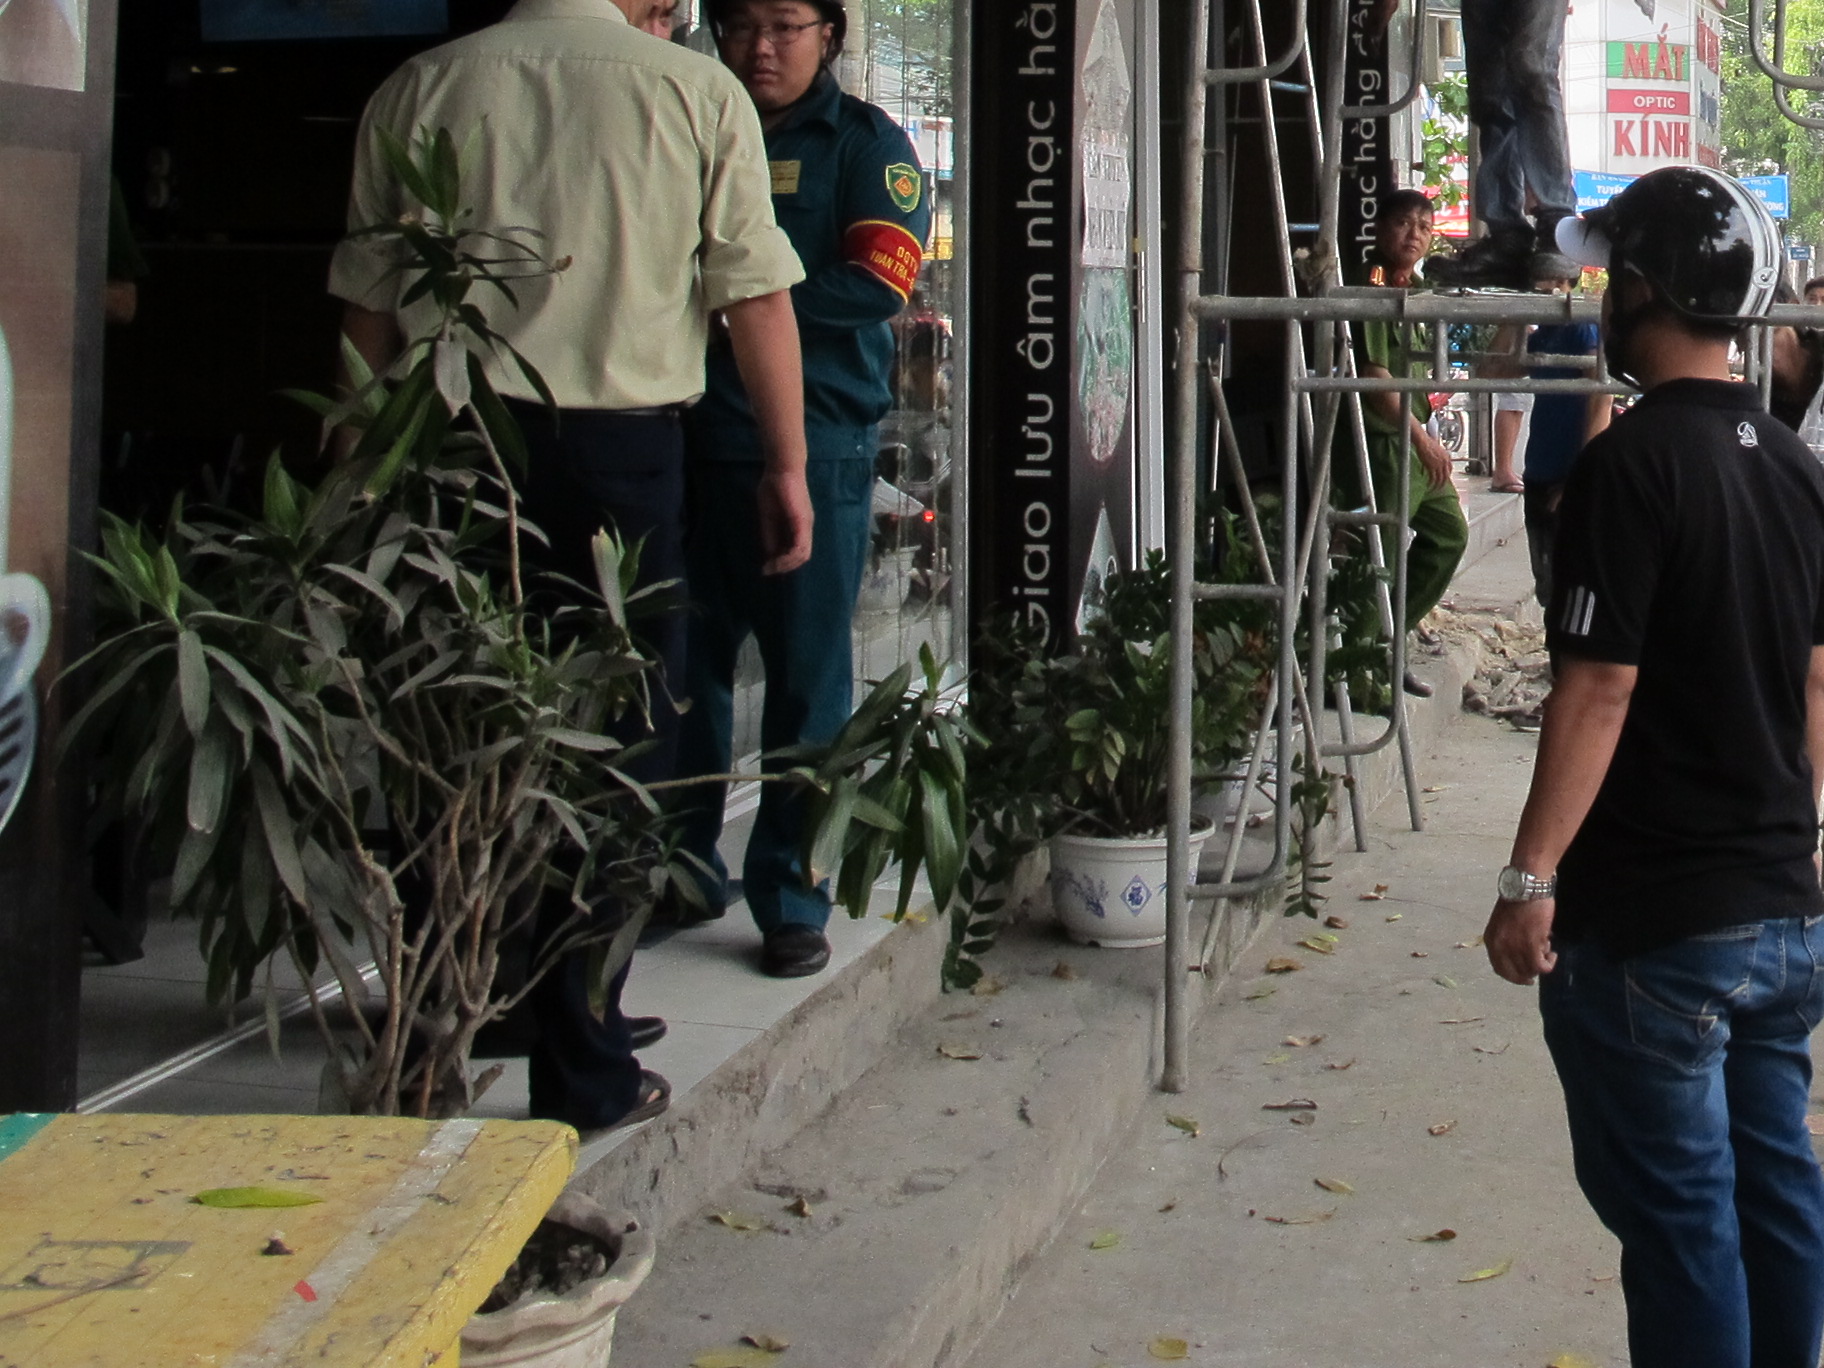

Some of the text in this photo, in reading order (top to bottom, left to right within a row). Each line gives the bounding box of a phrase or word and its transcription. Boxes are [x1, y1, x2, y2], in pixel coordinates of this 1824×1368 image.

[1623, 23, 1685, 81] MẮT
[1614, 112, 1690, 157] KÍNH
[1633, 95, 1676, 109] OPTIC
[1017, 97, 1063, 247] nhạc
[1019, 272, 1056, 371] âm
[1014, 390, 1053, 477] lưu
